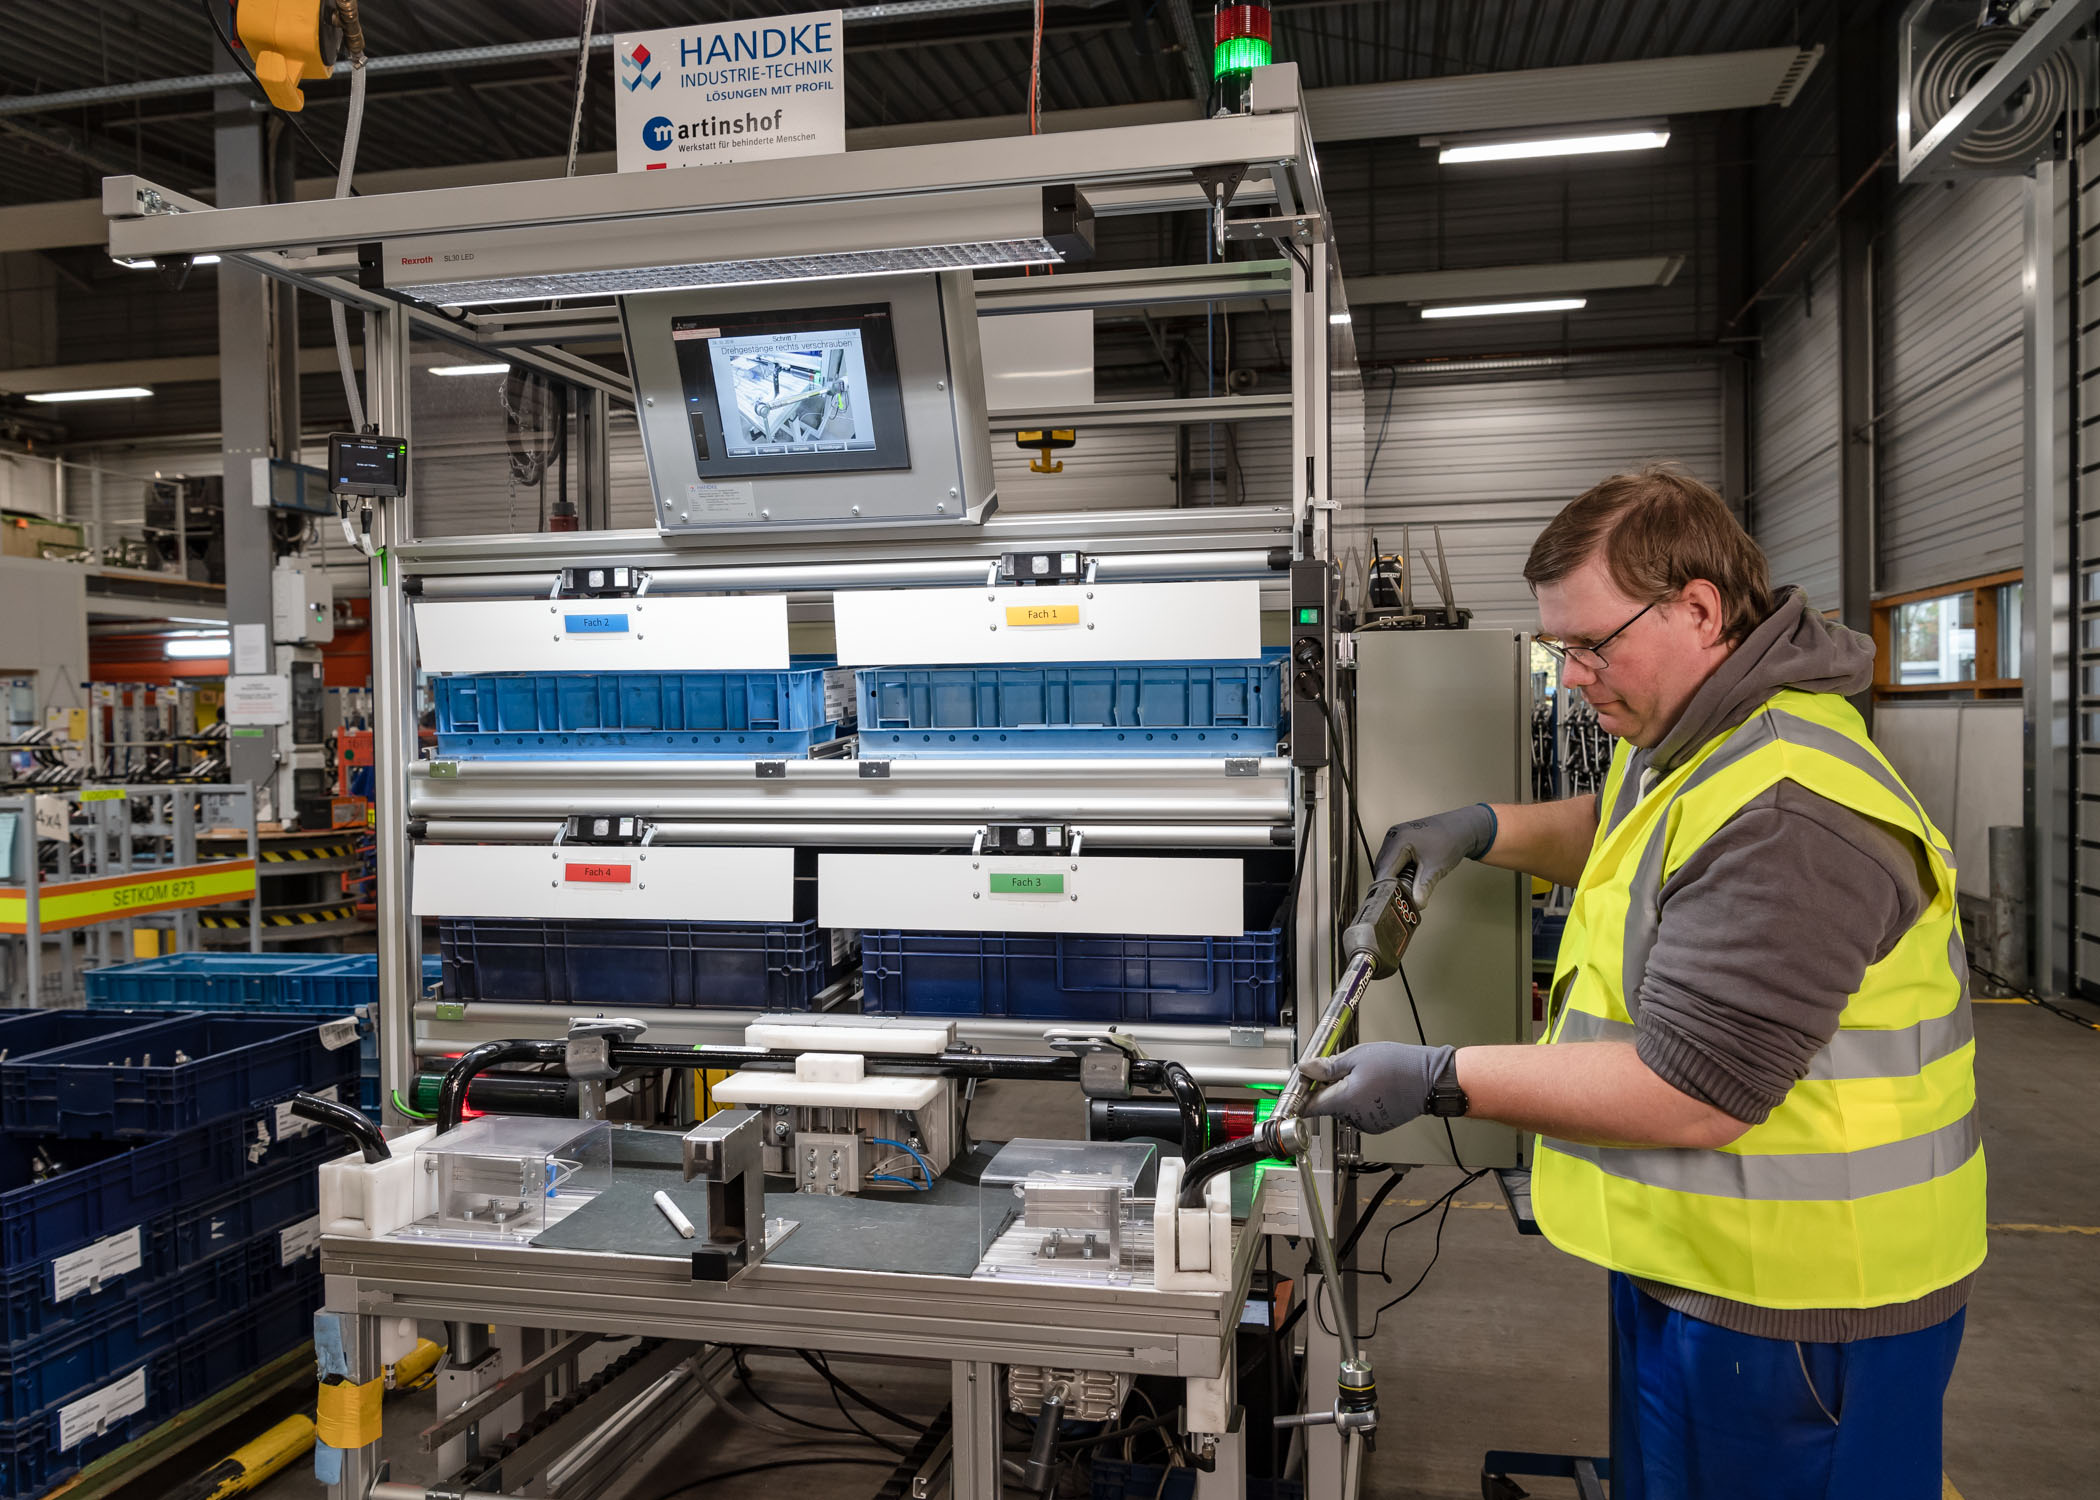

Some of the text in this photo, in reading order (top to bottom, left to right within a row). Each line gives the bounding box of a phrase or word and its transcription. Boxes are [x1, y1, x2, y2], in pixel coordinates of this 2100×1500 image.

[680, 22, 833, 67] HANDKE
[681, 58, 834, 88] INDUSTRIE-TECHNIK
[706, 81, 834, 102] LÖSUNGEN MIT PROFIL
[678, 132, 816, 152] Werkstatt für behinderte Menschen
[401, 256, 433, 265] Rexroth
[461, 253, 475, 261] LED
[772, 335, 792, 343] Schritt
[721, 339, 853, 355] Drehgestänge rechts verschrauben
[1028, 609, 1058, 619] Fach 1
[583, 618, 609, 627] Fach 2
[584, 867, 611, 877] Fach 4
[1012, 877, 1042, 887] Fach 3
[113, 880, 196, 906] SETKOM 873
